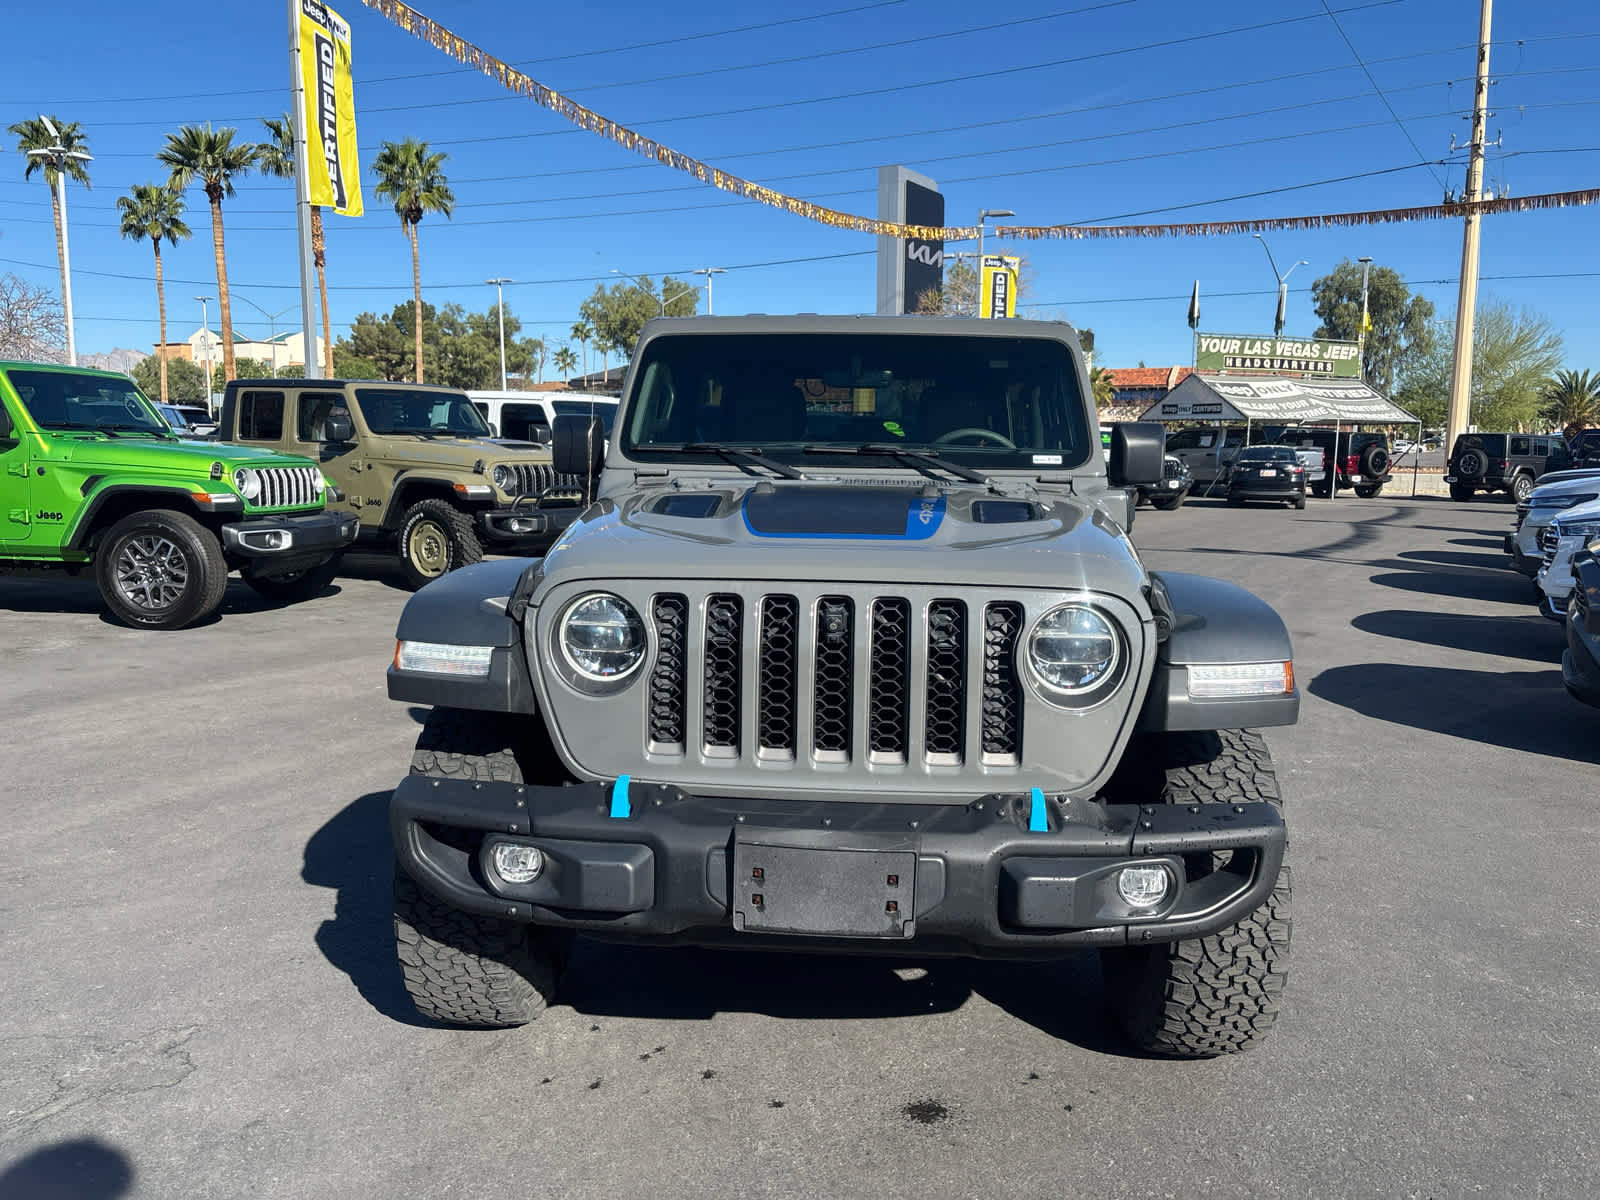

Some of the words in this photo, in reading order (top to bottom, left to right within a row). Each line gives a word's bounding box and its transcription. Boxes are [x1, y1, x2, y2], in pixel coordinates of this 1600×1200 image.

[303, 0, 327, 24] Jeep
[994, 274, 1005, 319] TIFIED
[1200, 338, 1241, 353] YOUR
[1243, 340, 1272, 355] LAS
[1276, 341, 1320, 358] VEGAS
[1323, 345, 1359, 360] JEEP
[1225, 357, 1333, 371] HEADQUARTERS
[1215, 383, 1255, 397] Jeep
[1256, 383, 1296, 394] ONLY
[1303, 386, 1374, 399] RTIFIED
[365, 496, 382, 506] Jeep
[36, 509, 63, 521] Jeep
